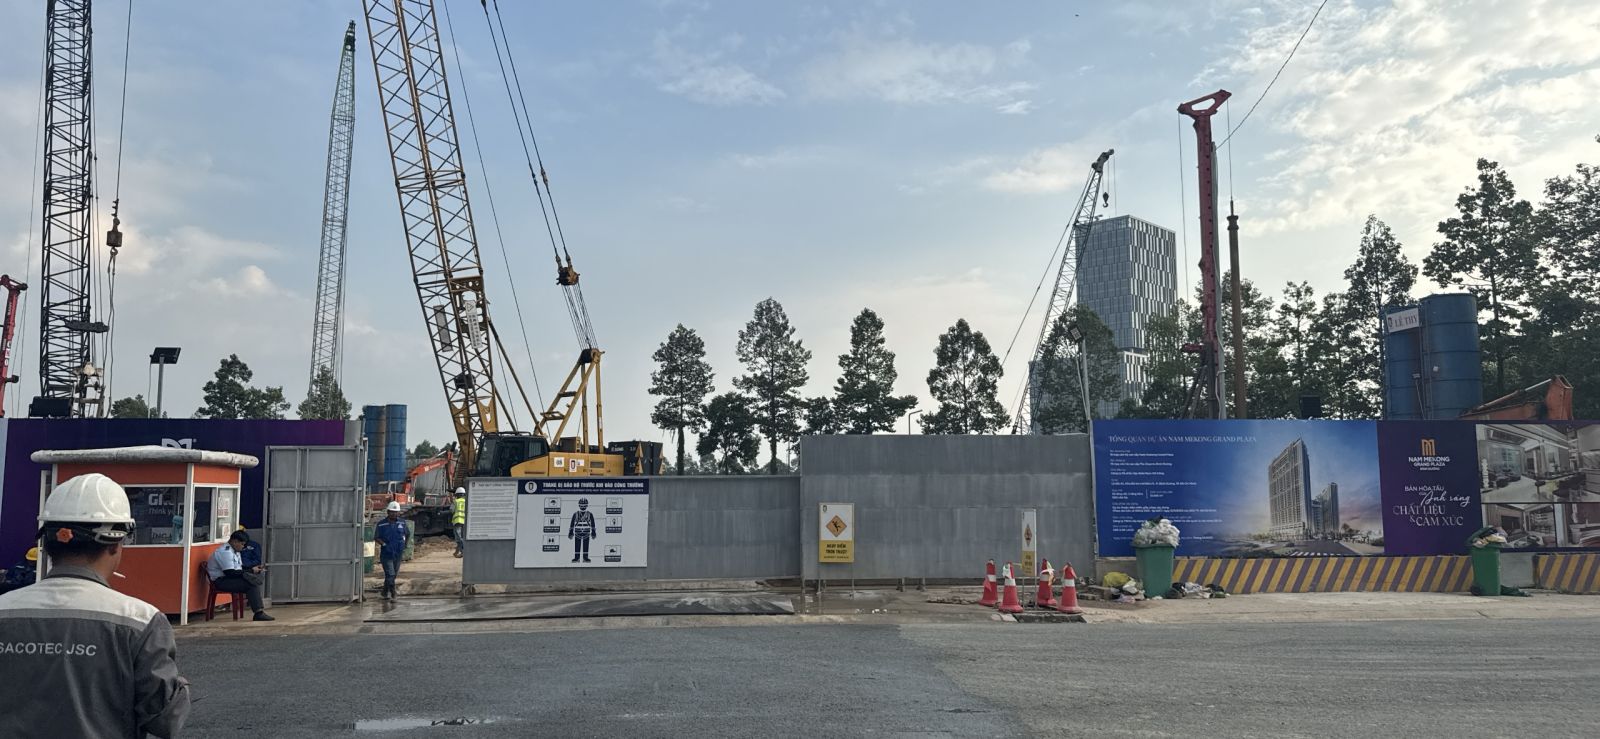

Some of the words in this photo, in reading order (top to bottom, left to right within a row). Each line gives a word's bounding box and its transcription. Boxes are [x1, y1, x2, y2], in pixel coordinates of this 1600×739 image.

[1127, 435, 1147, 443] QUAN
[1392, 502, 1421, 515] CHẤT
[1423, 503, 1446, 516] LIỆU
[1415, 514, 1440, 526] CẢM
[1442, 514, 1464, 526] XÚC
[66, 643, 97, 656] JSC
